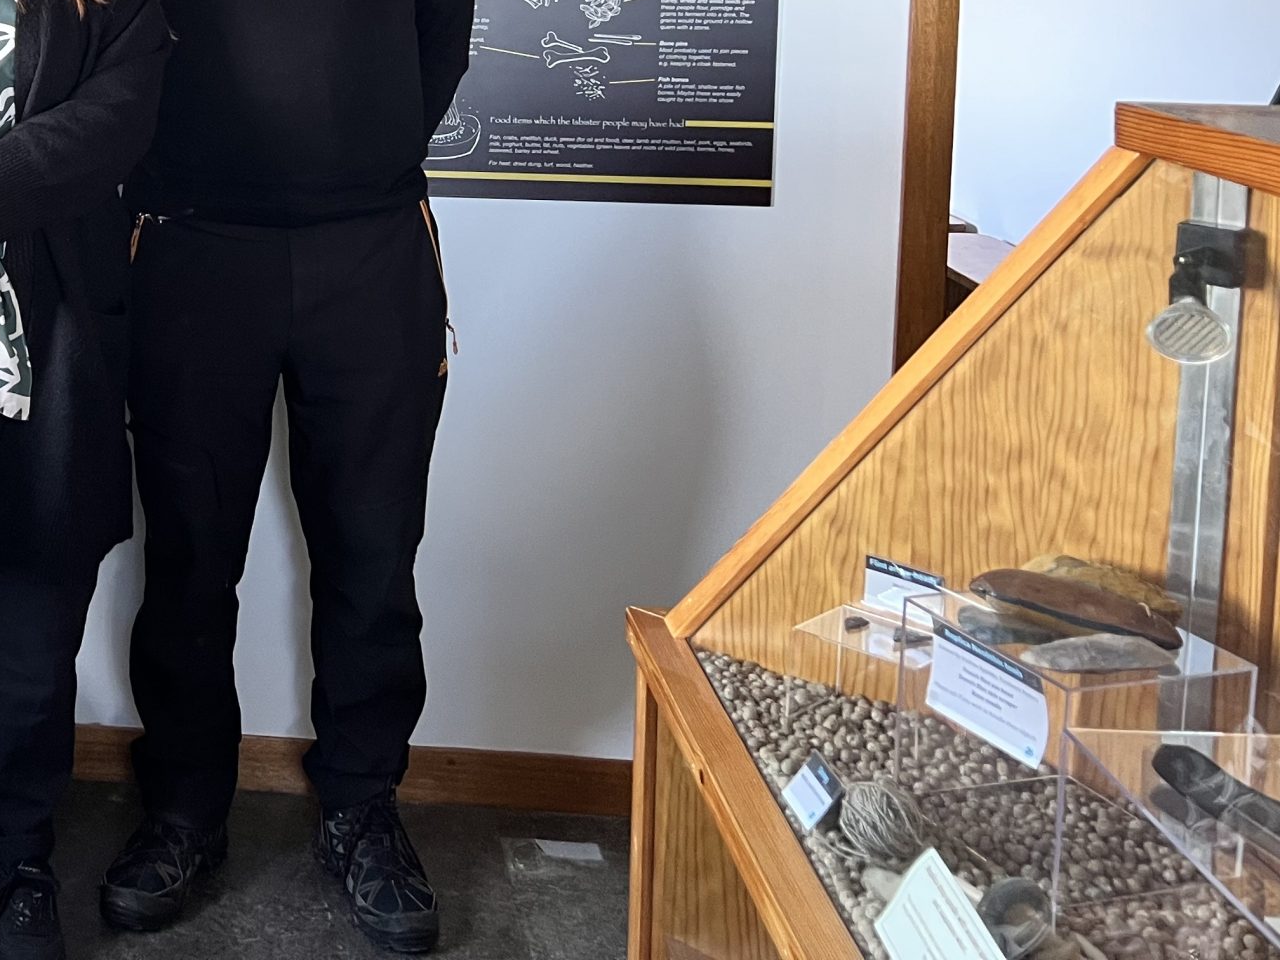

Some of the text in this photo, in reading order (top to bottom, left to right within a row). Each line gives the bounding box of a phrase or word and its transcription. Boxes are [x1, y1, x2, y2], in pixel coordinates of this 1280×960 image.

[490, 115, 511, 124] Food
[534, 116, 556, 124] which
[558, 116, 570, 125] the
[602, 117, 629, 130] people
[632, 121, 647, 130] may
[649, 118, 668, 128] have
[669, 118, 684, 128] had
